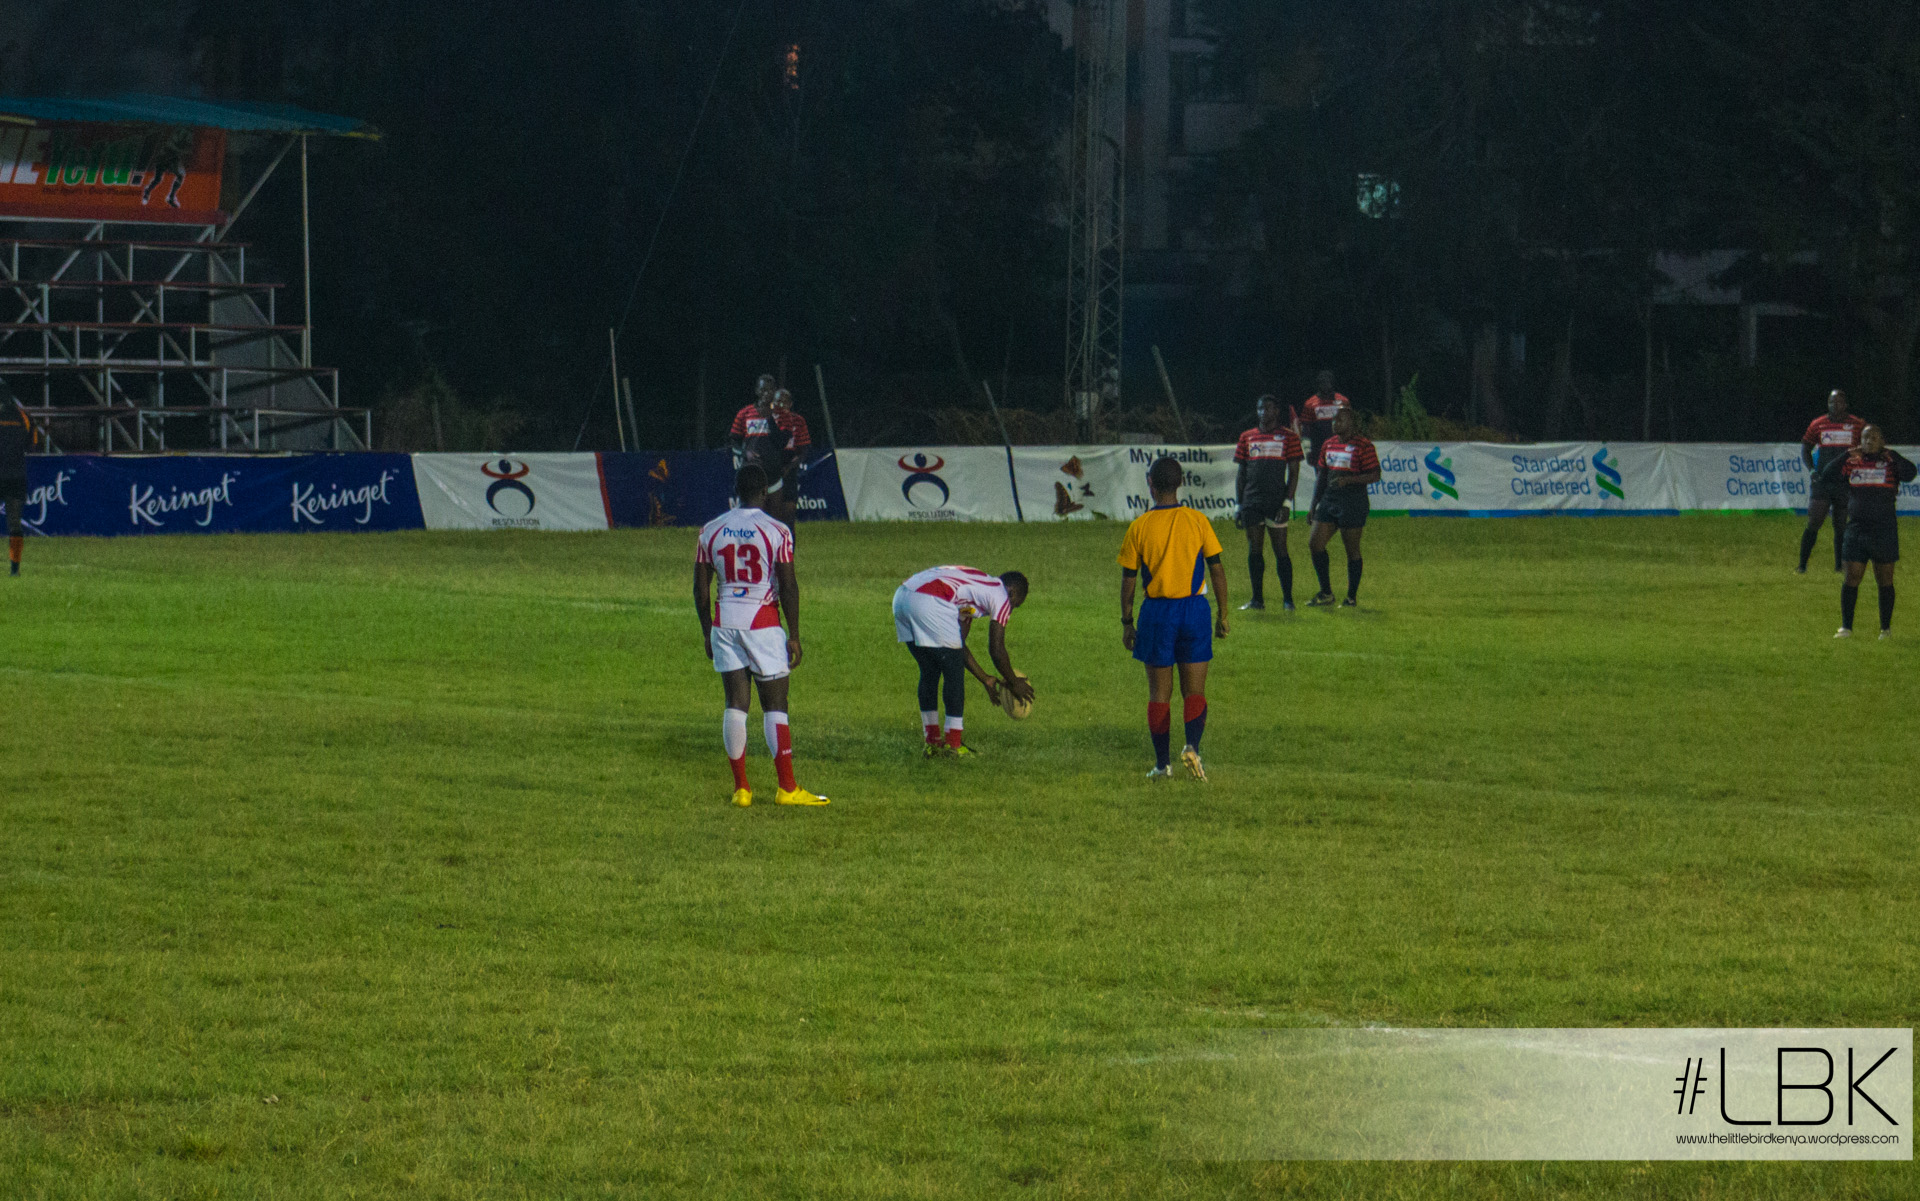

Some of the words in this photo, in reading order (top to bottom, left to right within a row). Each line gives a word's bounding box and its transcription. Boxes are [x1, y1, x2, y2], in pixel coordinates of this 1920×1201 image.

[1129, 448, 1153, 466] My
[1381, 455, 1418, 473] dard
[1511, 454, 1586, 473] Standard
[1729, 455, 1802, 473] Standard
[1367, 478, 1423, 495] artered
[1511, 477, 1591, 496] Chartered
[1726, 477, 1806, 496] Chartered
[128, 472, 236, 526] Keringet
[290, 470, 394, 525] Keringet
[1126, 495, 1149, 512] My
[1179, 495, 1236, 510] olution
[492, 518, 540, 526] RESOLUTION
[908, 509, 955, 519] RESOLUTION
[723, 527, 757, 539] Protex
[717, 543, 763, 584] 13
